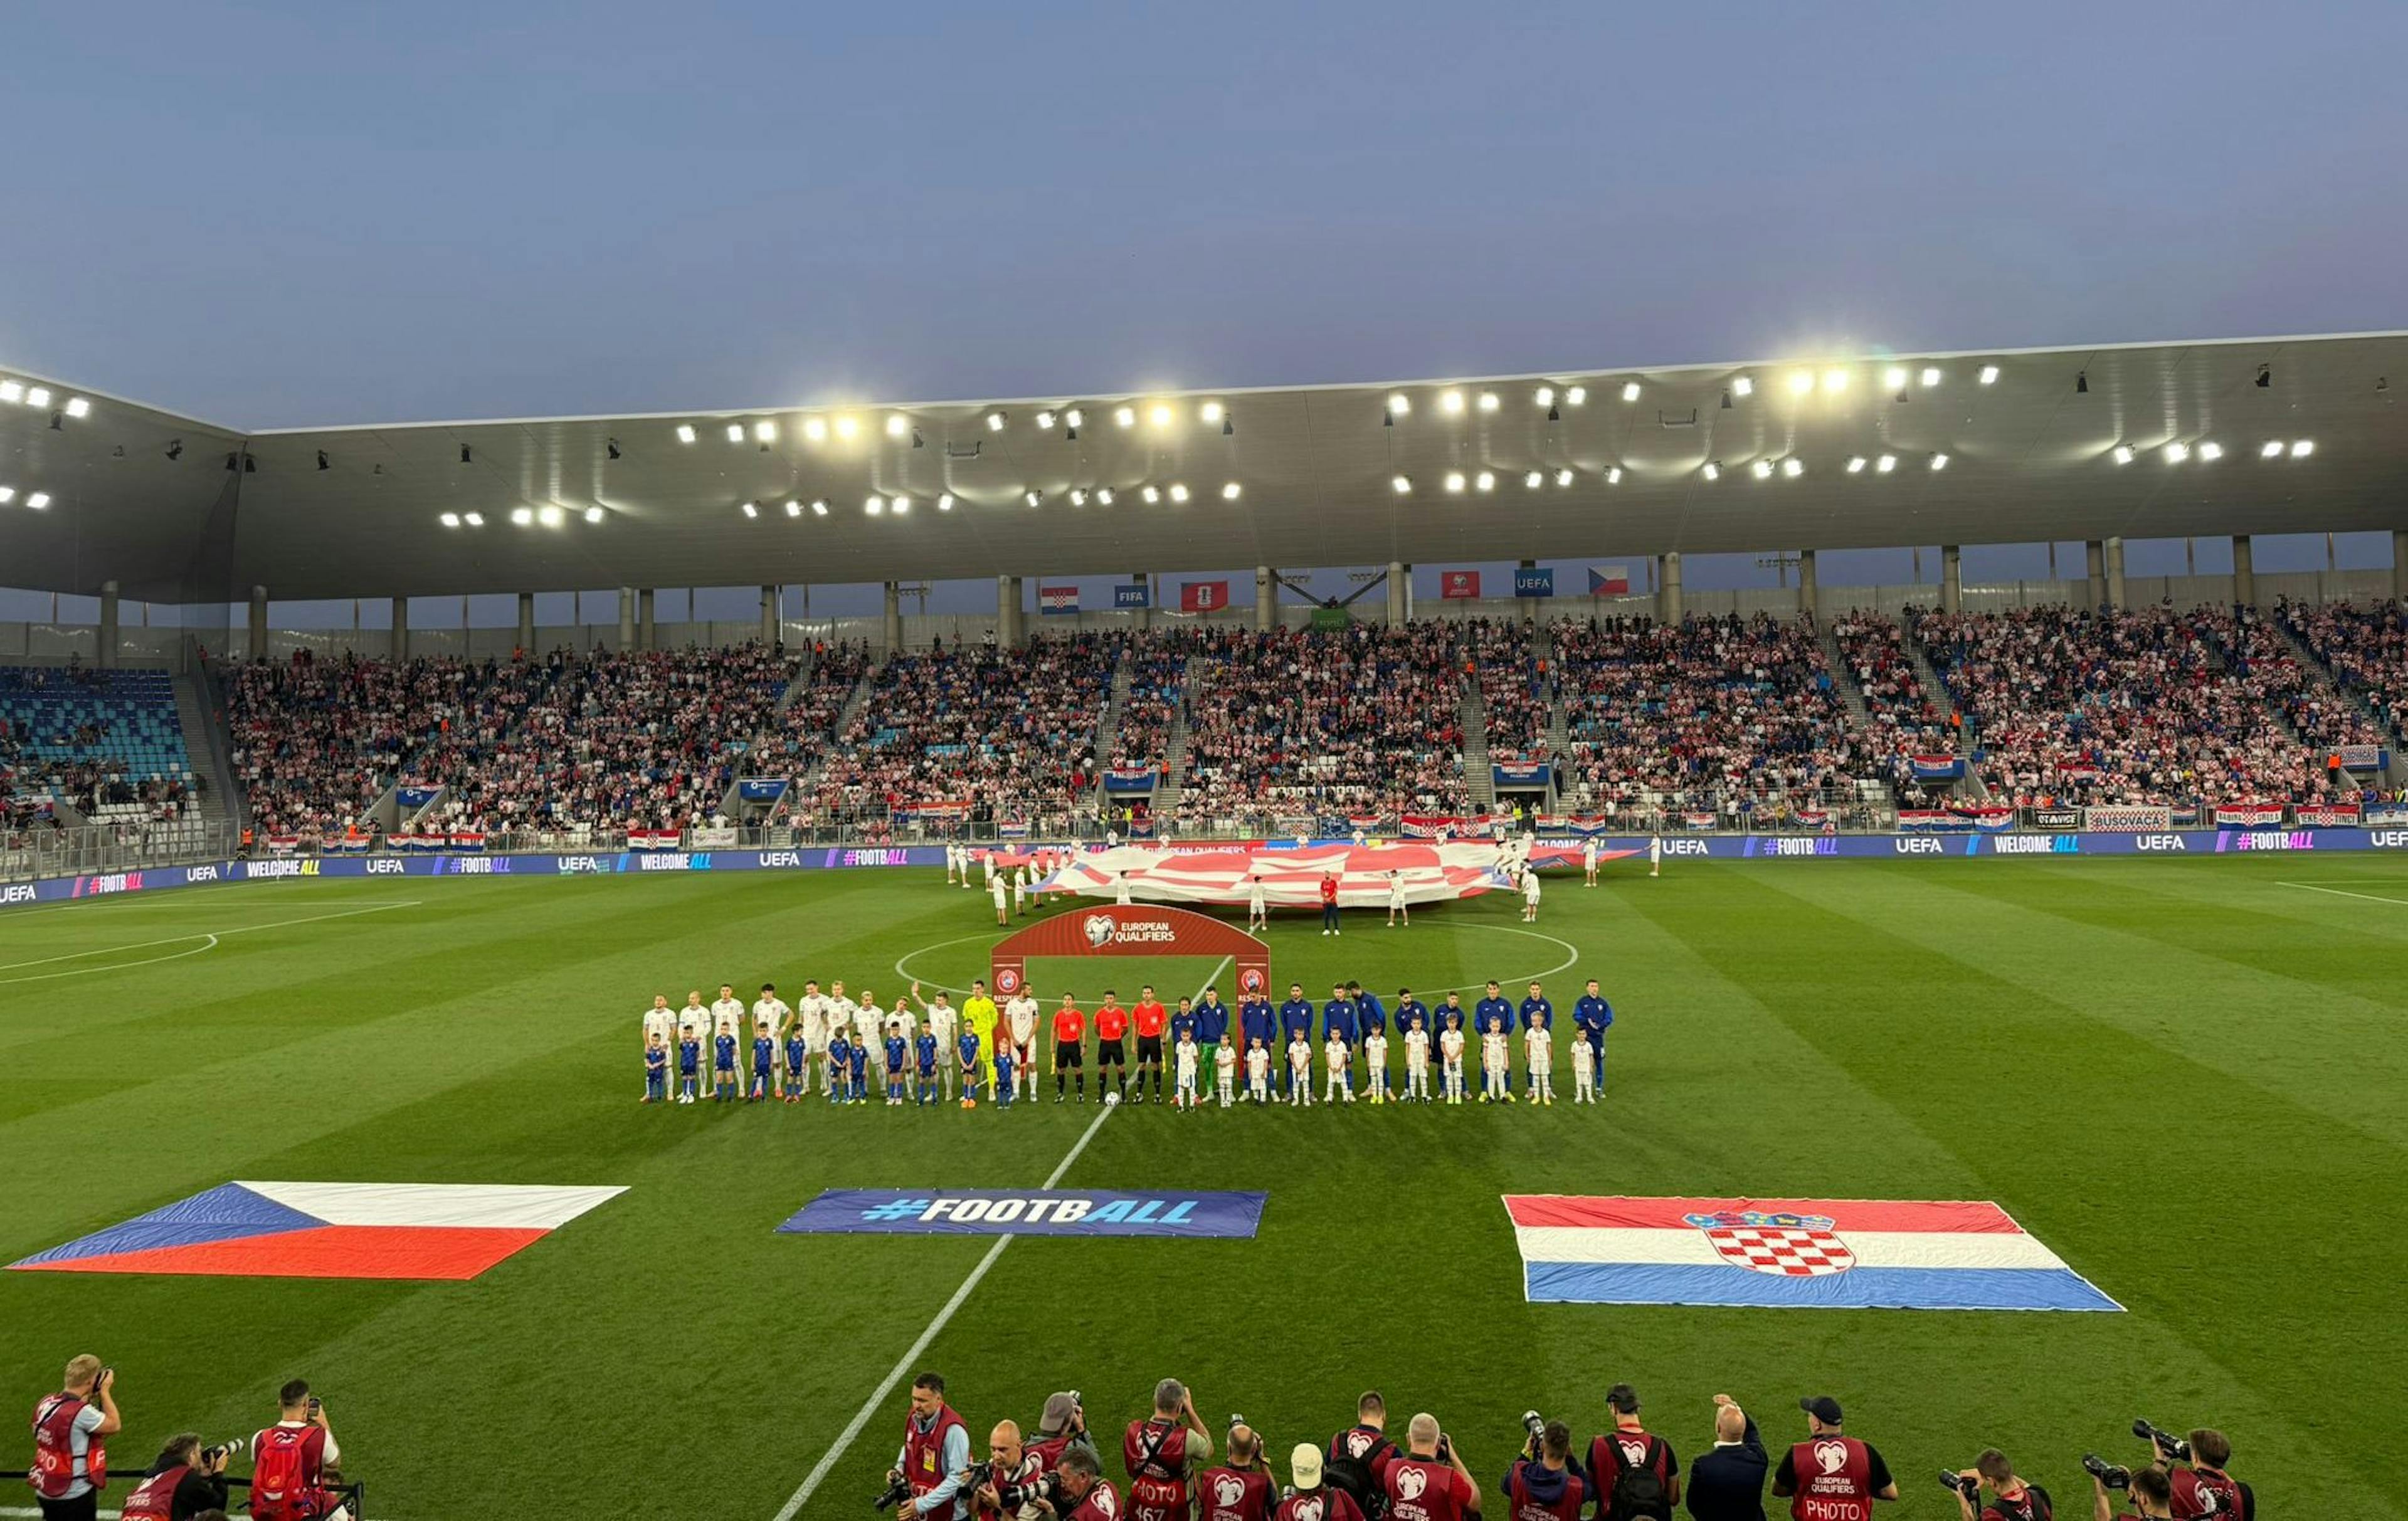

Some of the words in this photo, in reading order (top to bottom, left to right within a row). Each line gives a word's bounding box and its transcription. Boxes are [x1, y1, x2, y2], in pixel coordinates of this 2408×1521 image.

[1516, 579, 1550, 589] UEFA
[1119, 592, 1143, 603] FIFA
[1662, 839, 1708, 855] UEFA
[1763, 838, 1837, 855] #FOOTBALL
[1896, 838, 1943, 853] UEFA
[1995, 836, 2052, 853] WELCOME
[2053, 835, 2079, 852] ALL
[2136, 834, 2185, 850] UEFA
[2237, 831, 2314, 850] #FOOTBALL
[450, 857, 510, 873] #FOOTBALL
[558, 856, 597, 871] UEFA
[641, 854, 690, 870] WELCOME
[690, 853, 711, 869] ALL
[759, 852, 800, 866] UEFA
[843, 849, 907, 865] #FOOTBALL
[187, 866, 218, 881] UEFA
[247, 860, 300, 877] WELCOME
[300, 859, 320, 875] ALL
[367, 860, 403, 873] UEFA
[89, 872, 143, 893] #FOOTBALL
[1121, 922, 1169, 931] EUROPEAN
[1116, 930, 1175, 942] QUALIFIERS
[860, 1199, 1198, 1224] #FOOTBALL
[1811, 1484, 1855, 1493] QUALIFIERS
[1815, 1476, 1851, 1485] EUROPEAN
[1806, 1500, 1859, 1520] PHOTO
